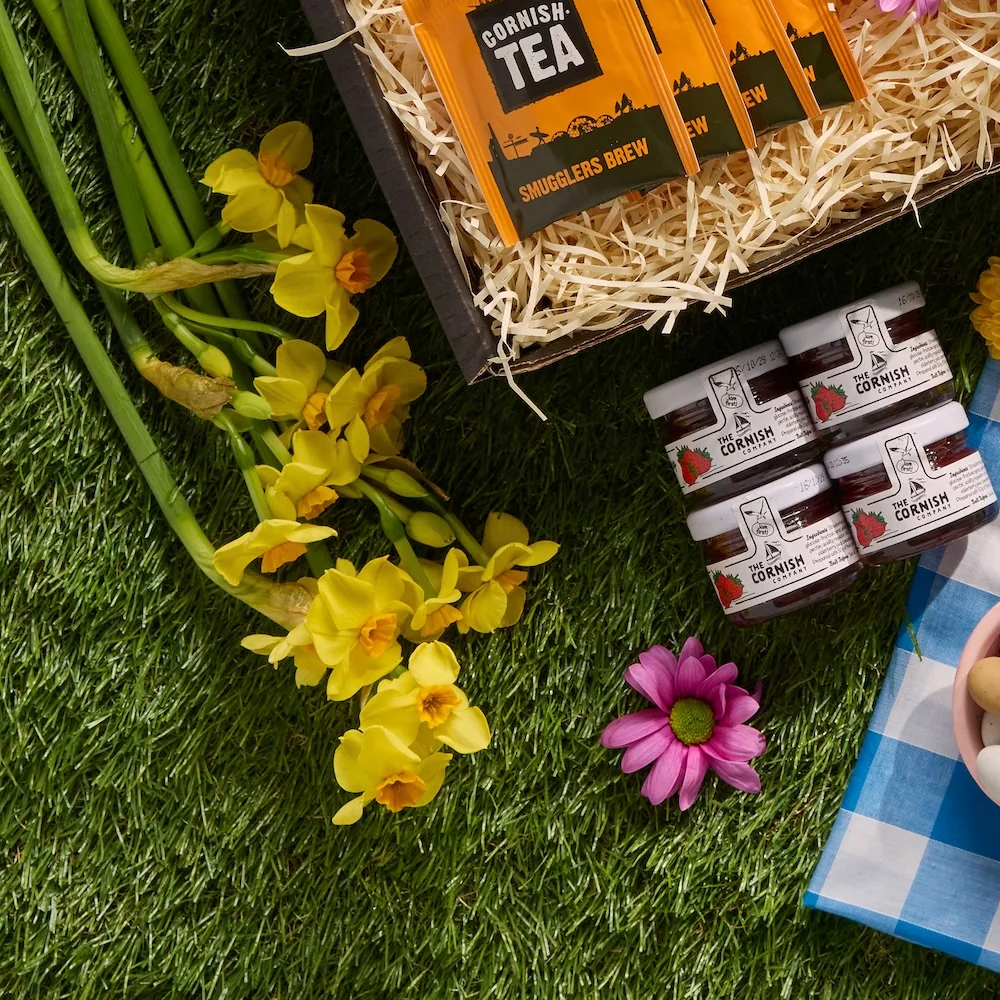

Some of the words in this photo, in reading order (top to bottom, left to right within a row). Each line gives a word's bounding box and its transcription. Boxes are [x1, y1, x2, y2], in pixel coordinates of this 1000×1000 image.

[494, 23, 585, 90] TEA
[741, 83, 768, 109] EW
[684, 115, 709, 139] EW
[518, 160, 603, 203] SMUGGLERS
[603, 137, 649, 170] BREW
[853, 371, 870, 383] THE
[856, 365, 910, 394] CORNISH
[878, 377, 912, 394] COMPANY
[717, 433, 734, 445] THE
[720, 425, 775, 456] CORNISH
[742, 437, 777, 455] COMPANY
[892, 498, 908, 510] THE
[895, 491, 949, 521] CORNISH
[917, 503, 951, 520] COMPANY
[748, 561, 764, 573] THE
[751, 554, 805, 584] CORNISH
[773, 566, 807, 583] COMPANY
